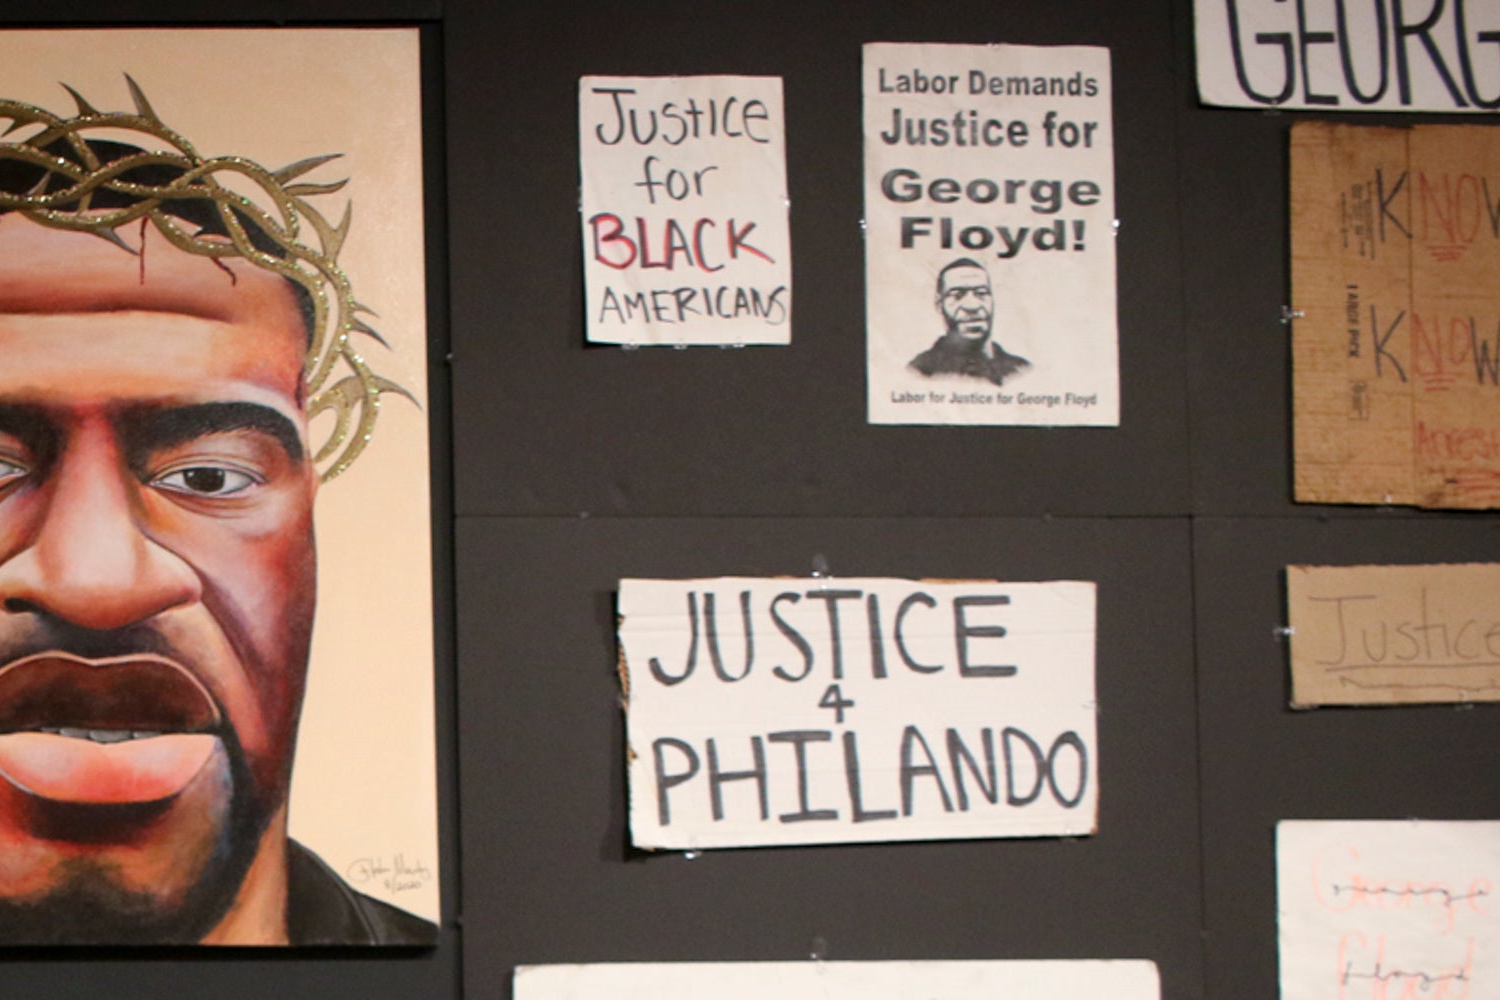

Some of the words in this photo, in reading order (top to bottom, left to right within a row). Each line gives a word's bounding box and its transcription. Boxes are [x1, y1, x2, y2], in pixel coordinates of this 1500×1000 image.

[878, 68, 958, 94] Labor
[969, 69, 1098, 97] Demands
[592, 87, 769, 145] Justice
[880, 108, 1028, 147] Justice
[1043, 110, 1099, 149] for
[634, 156, 718, 203] for
[880, 168, 1102, 213] George
[588, 213, 776, 271] BLACK
[899, 217, 1086, 259] Floyd!
[598, 285, 787, 325] AMERICANS
[891, 391, 925, 404] Labor
[929, 391, 946, 404] for
[950, 391, 993, 405] Justice
[996, 392, 1013, 405] for
[1017, 392, 1061, 408] George
[1065, 392, 1097, 408] Floyd
[649, 589, 1017, 686] JUSTICE
[817, 685, 855, 724] 4
[651, 724, 1088, 827] PHILANDO
